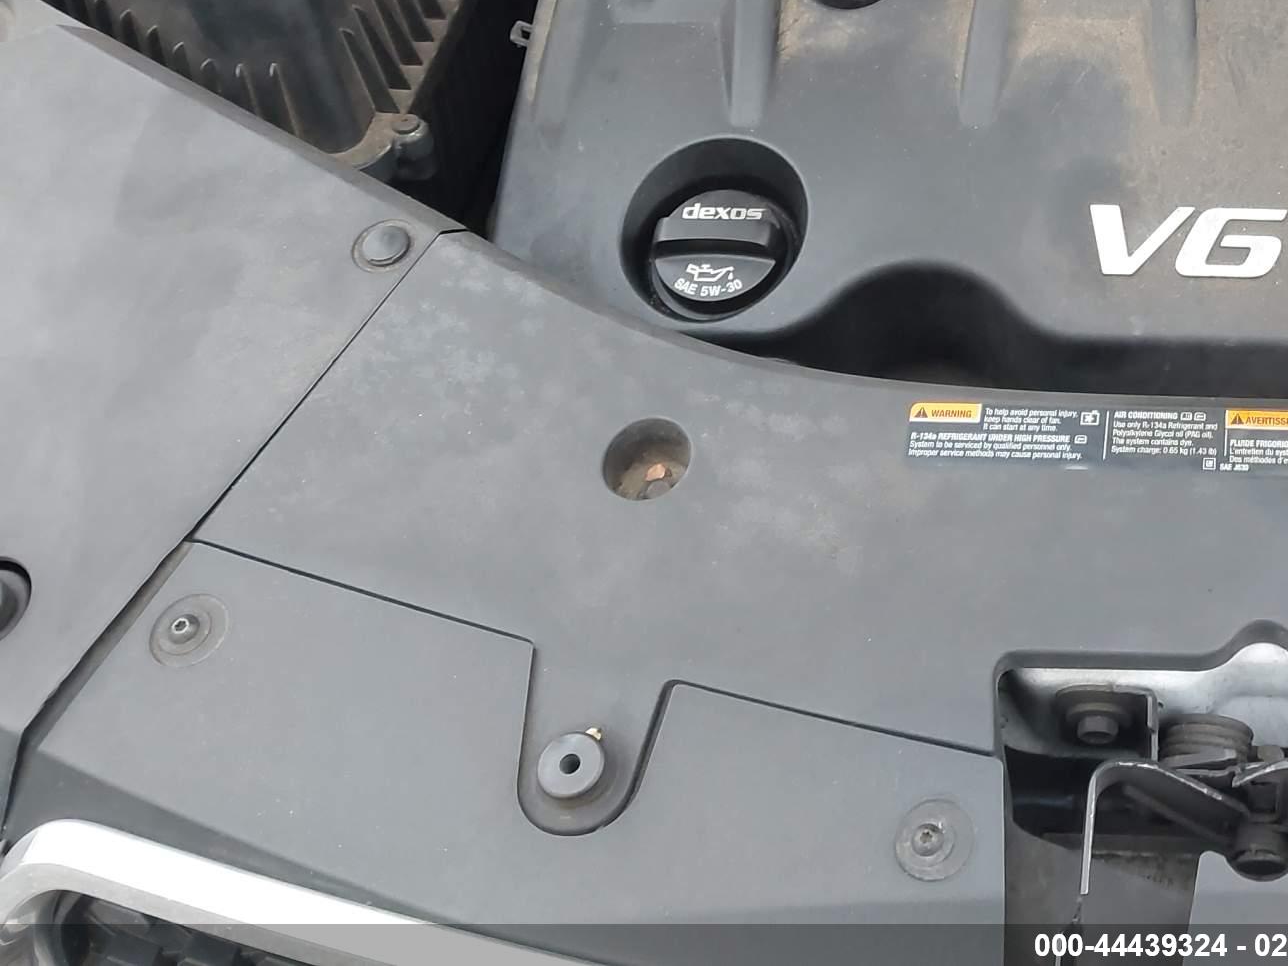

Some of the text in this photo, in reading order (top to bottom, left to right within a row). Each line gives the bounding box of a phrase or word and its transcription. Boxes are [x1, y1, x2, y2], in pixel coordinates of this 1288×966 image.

[682, 203, 768, 221] dexos
[1089, 204, 1288, 278] V6
[674, 278, 743, 297] SAE 5W-30
[931, 409, 972, 418] WARNING
[1114, 411, 1178, 420] AIR CONDITIONING
[911, 432, 1071, 443] R-134a REFRIGERANT UNDER HIGH PRESSURE
[1230, 439, 1255, 447] FLUIDE
[1219, 463, 1233, 471] SAE
